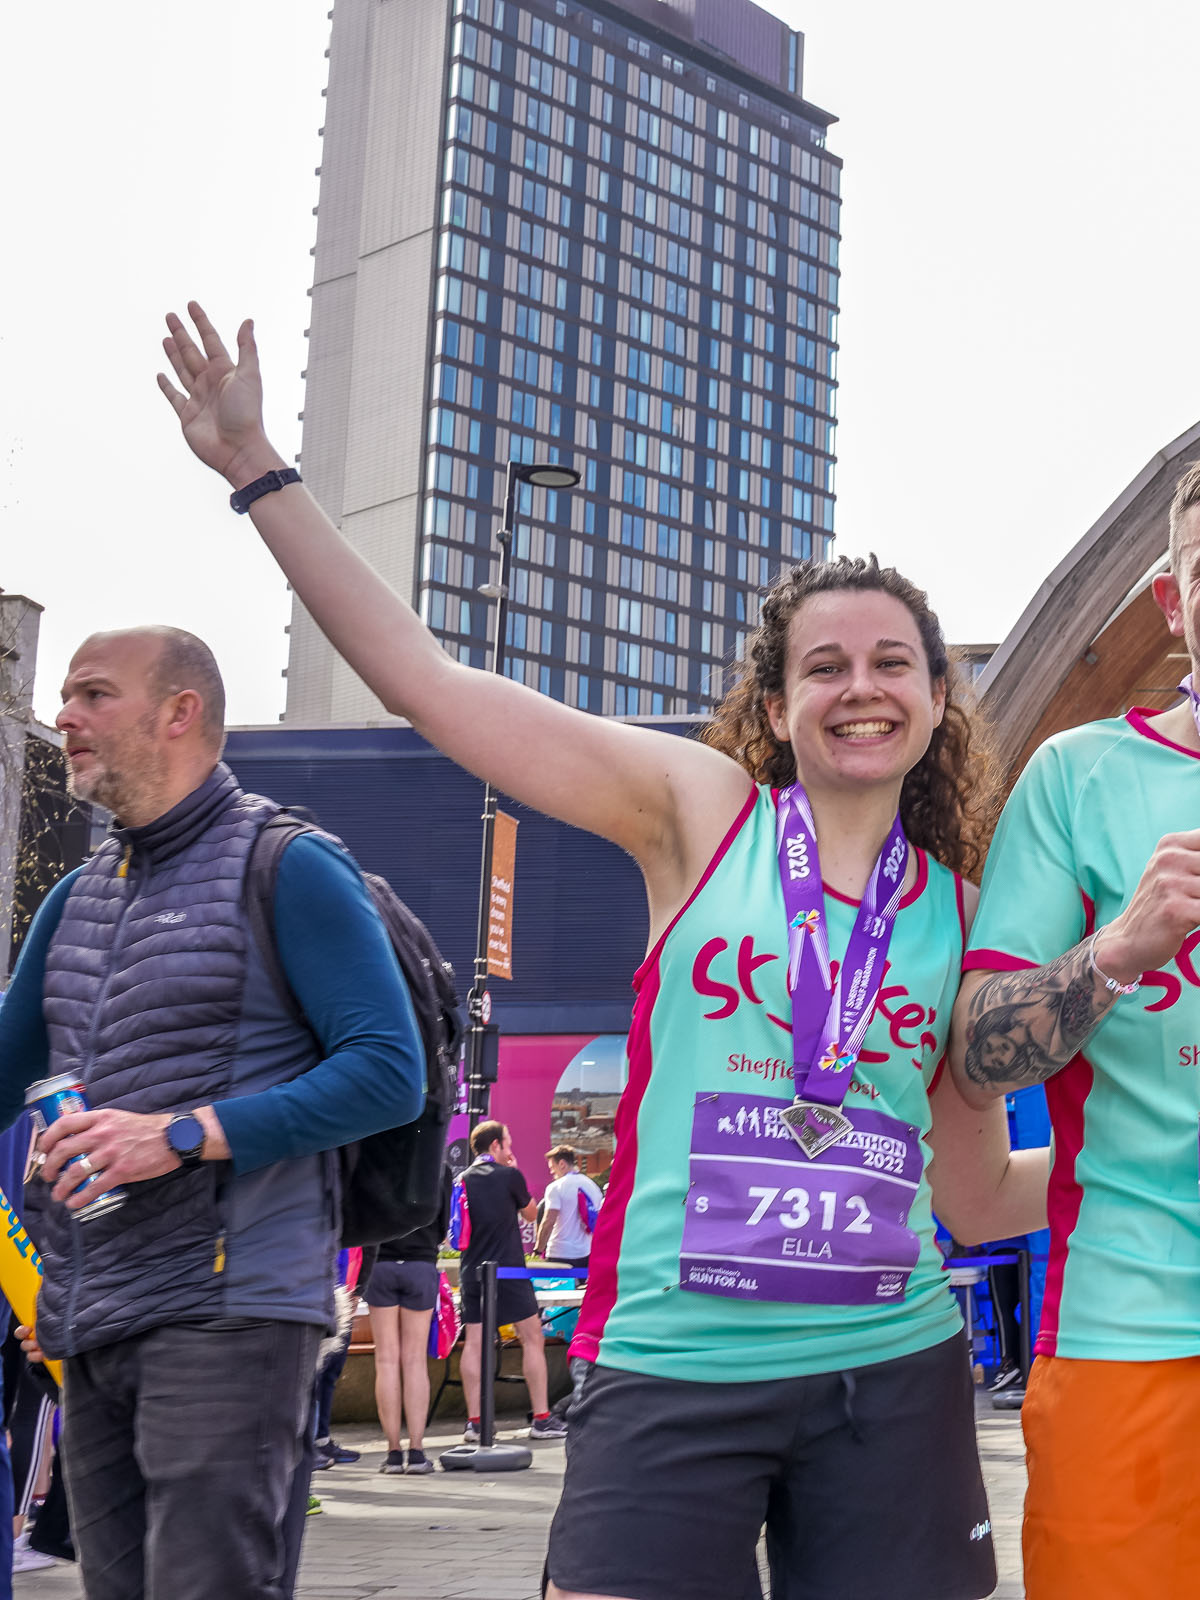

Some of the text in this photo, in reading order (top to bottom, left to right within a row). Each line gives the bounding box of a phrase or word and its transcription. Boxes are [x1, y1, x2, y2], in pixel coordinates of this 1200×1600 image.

[786, 832, 811, 881] 2022
[883, 835, 906, 884] 2022
[691, 935, 781, 1020] St
[727, 1054, 796, 1081] Sheffie
[862, 1150, 905, 1175] 2022
[694, 1196, 709, 1214] S
[745, 1186, 873, 1234] 7312
[782, 1237, 833, 1259] ELLA
[688, 1271, 759, 1291] RUN FOR ALL
